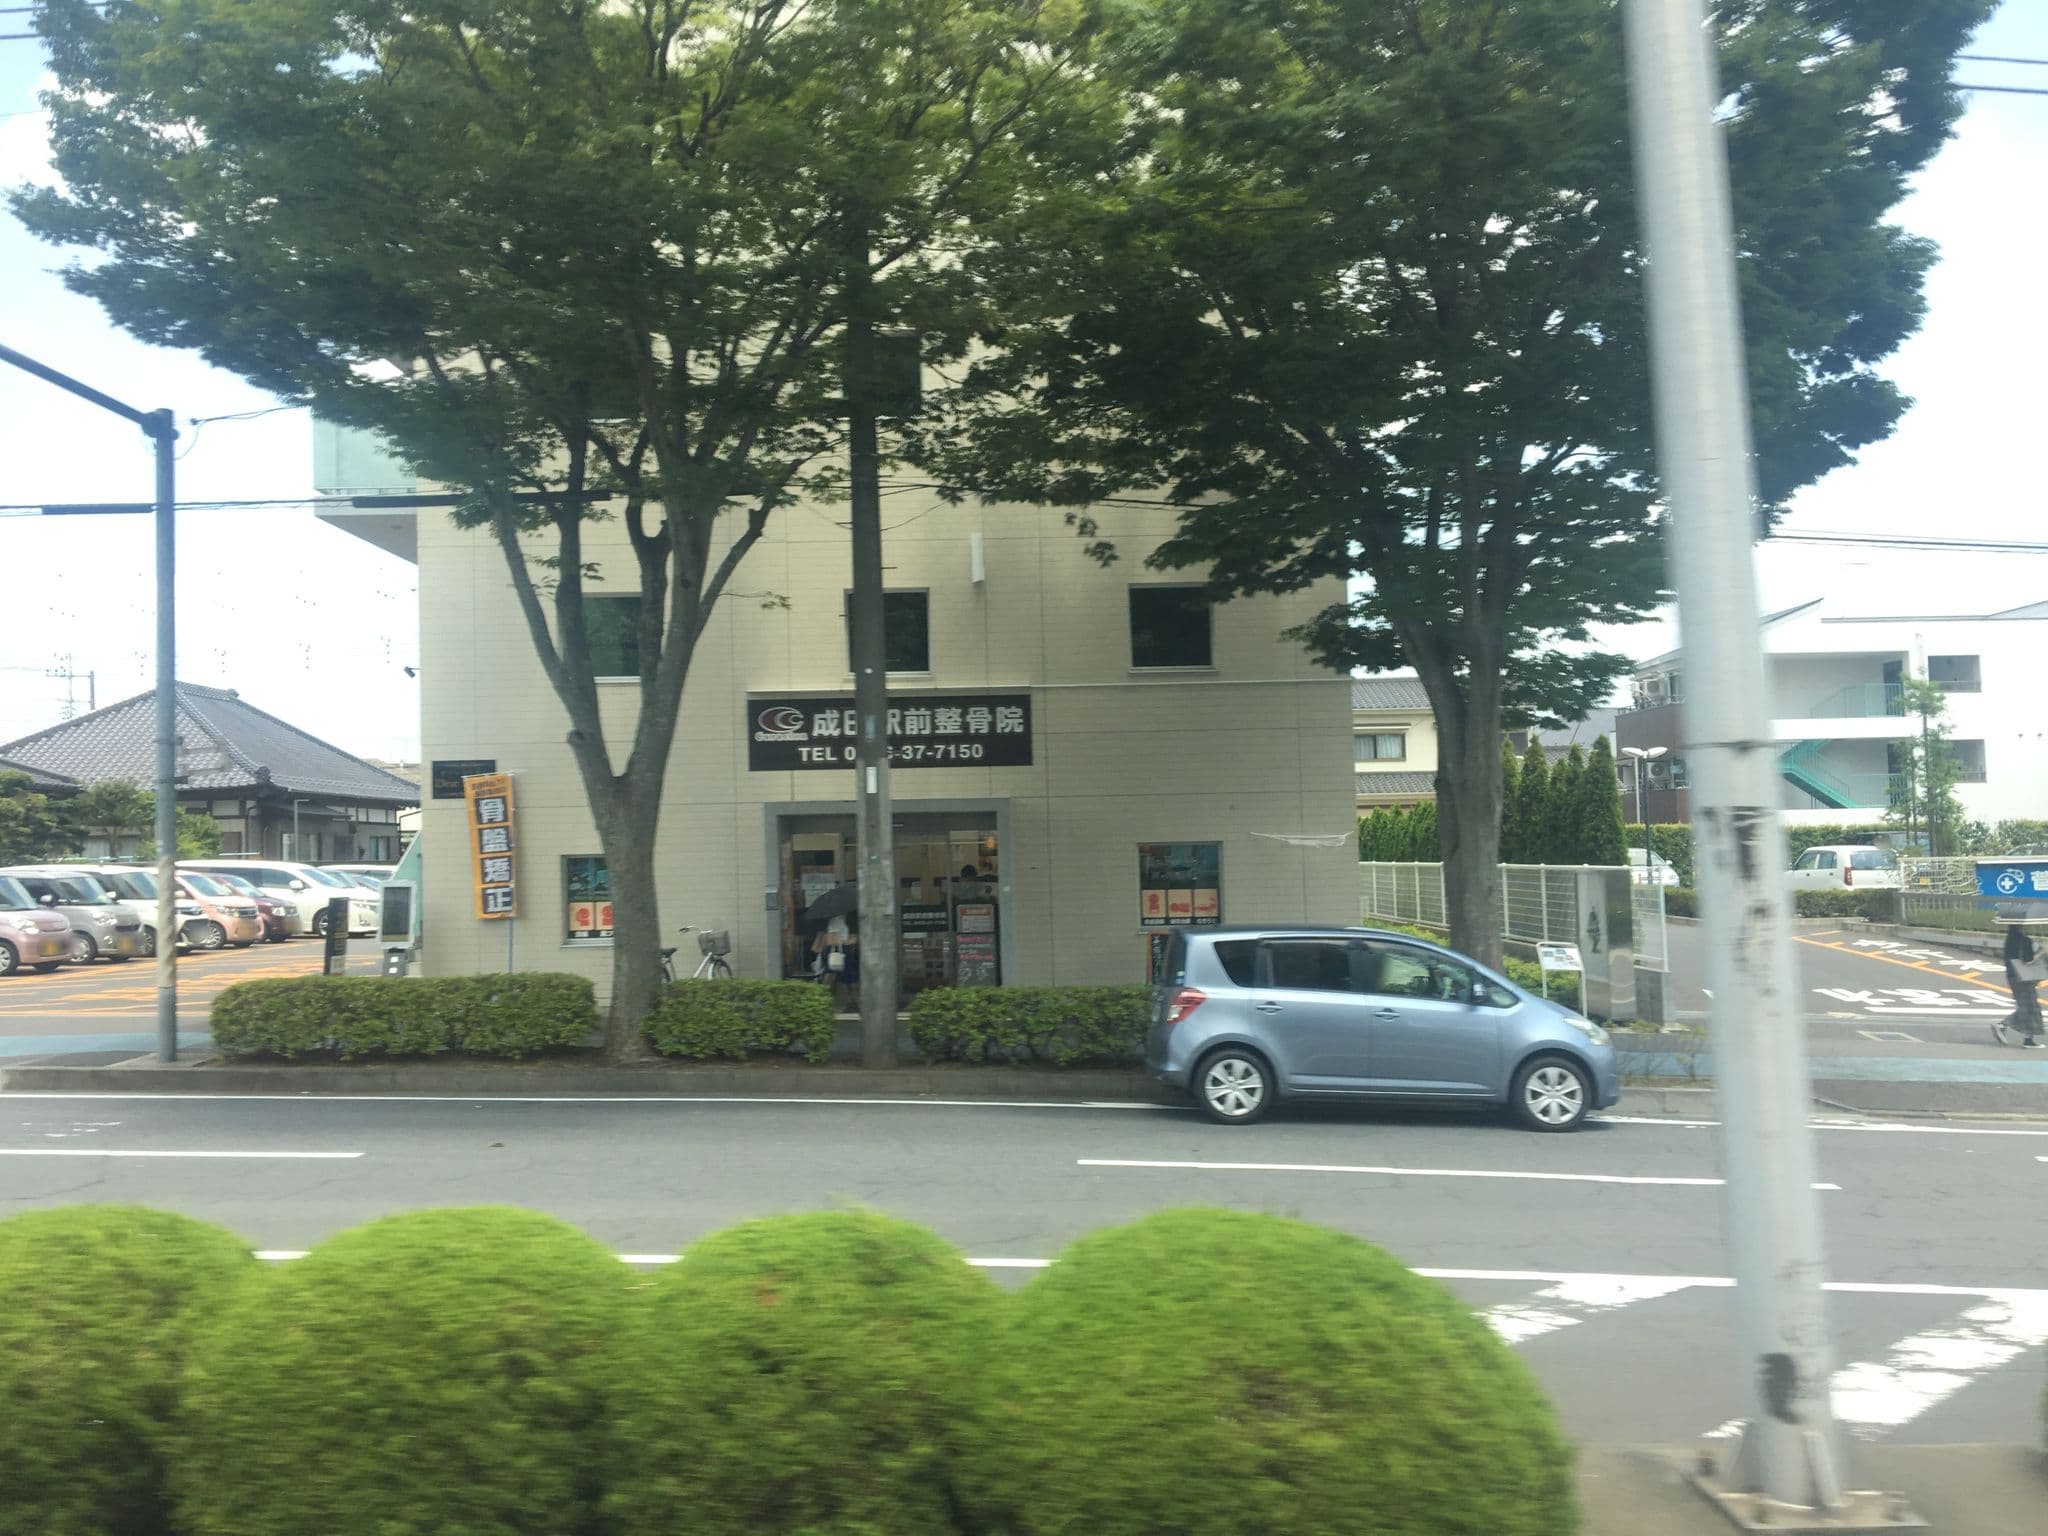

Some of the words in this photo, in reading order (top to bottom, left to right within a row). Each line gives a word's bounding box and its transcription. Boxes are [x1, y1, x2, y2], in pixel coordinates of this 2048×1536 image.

[798, 747, 838, 761] TEL
[479, 797, 513, 913] 骨盤矯正
